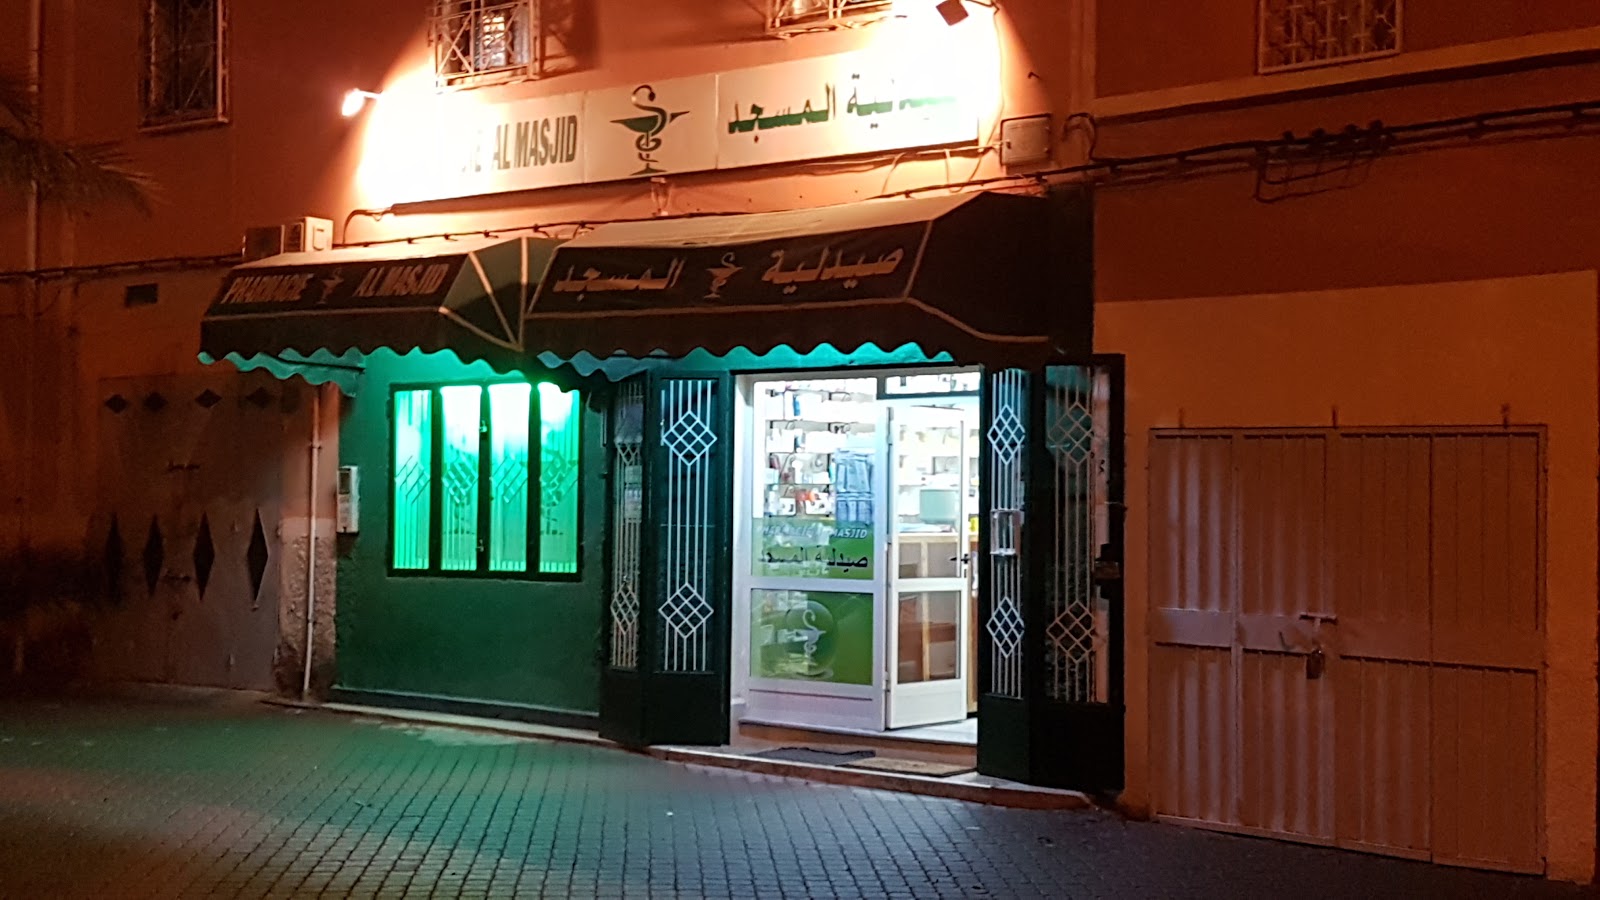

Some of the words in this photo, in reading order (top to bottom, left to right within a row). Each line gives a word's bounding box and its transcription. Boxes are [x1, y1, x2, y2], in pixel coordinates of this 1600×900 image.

[728, 83, 835, 143] المسجد
[492, 123, 511, 170] AL
[513, 115, 578, 168] MASJID
[352, 267, 384, 297] AL
[376, 263, 449, 296] MASJID
[553, 256, 685, 302] المسجد
[761, 248, 904, 295] صيدلية
